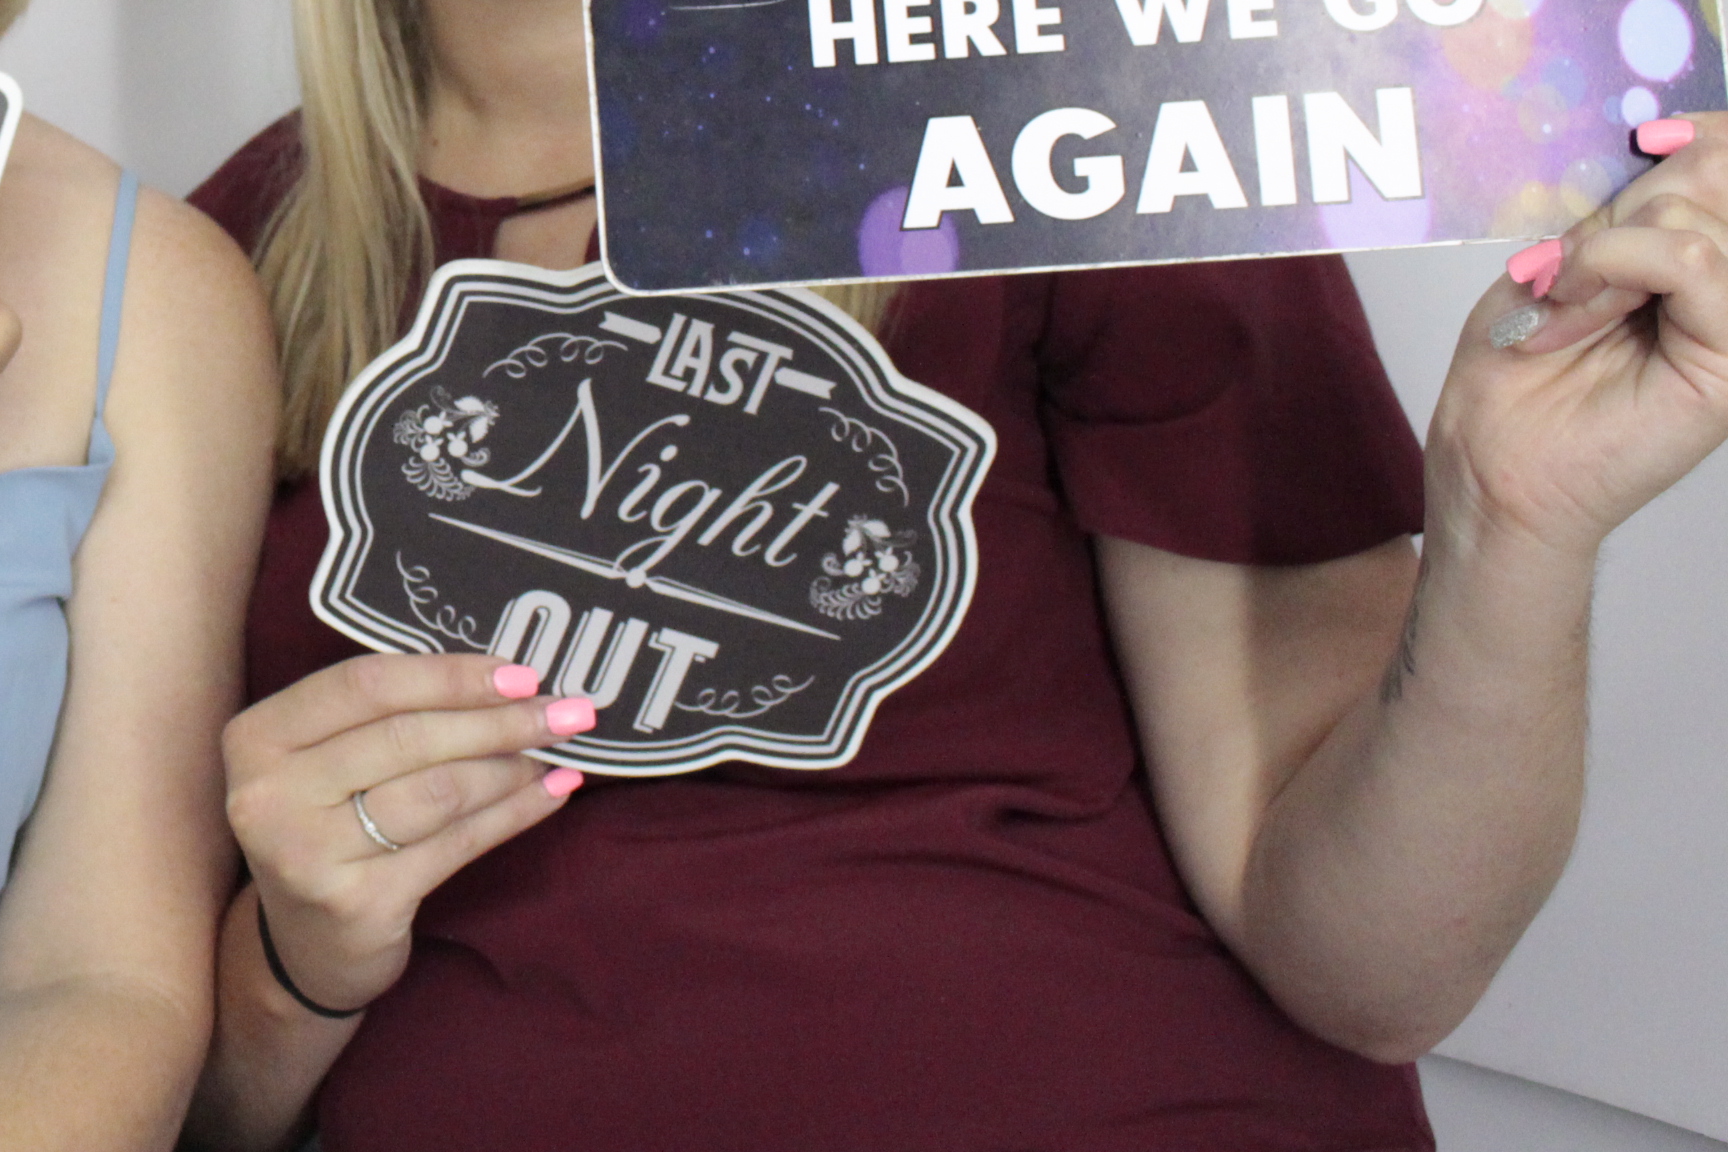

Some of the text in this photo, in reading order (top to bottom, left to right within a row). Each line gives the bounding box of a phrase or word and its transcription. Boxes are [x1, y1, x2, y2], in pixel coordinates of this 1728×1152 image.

[902, 88, 1424, 230] AGAIN
[646, 313, 793, 414] LAST
[462, 378, 840, 581] Night
[486, 590, 719, 733] OUT
